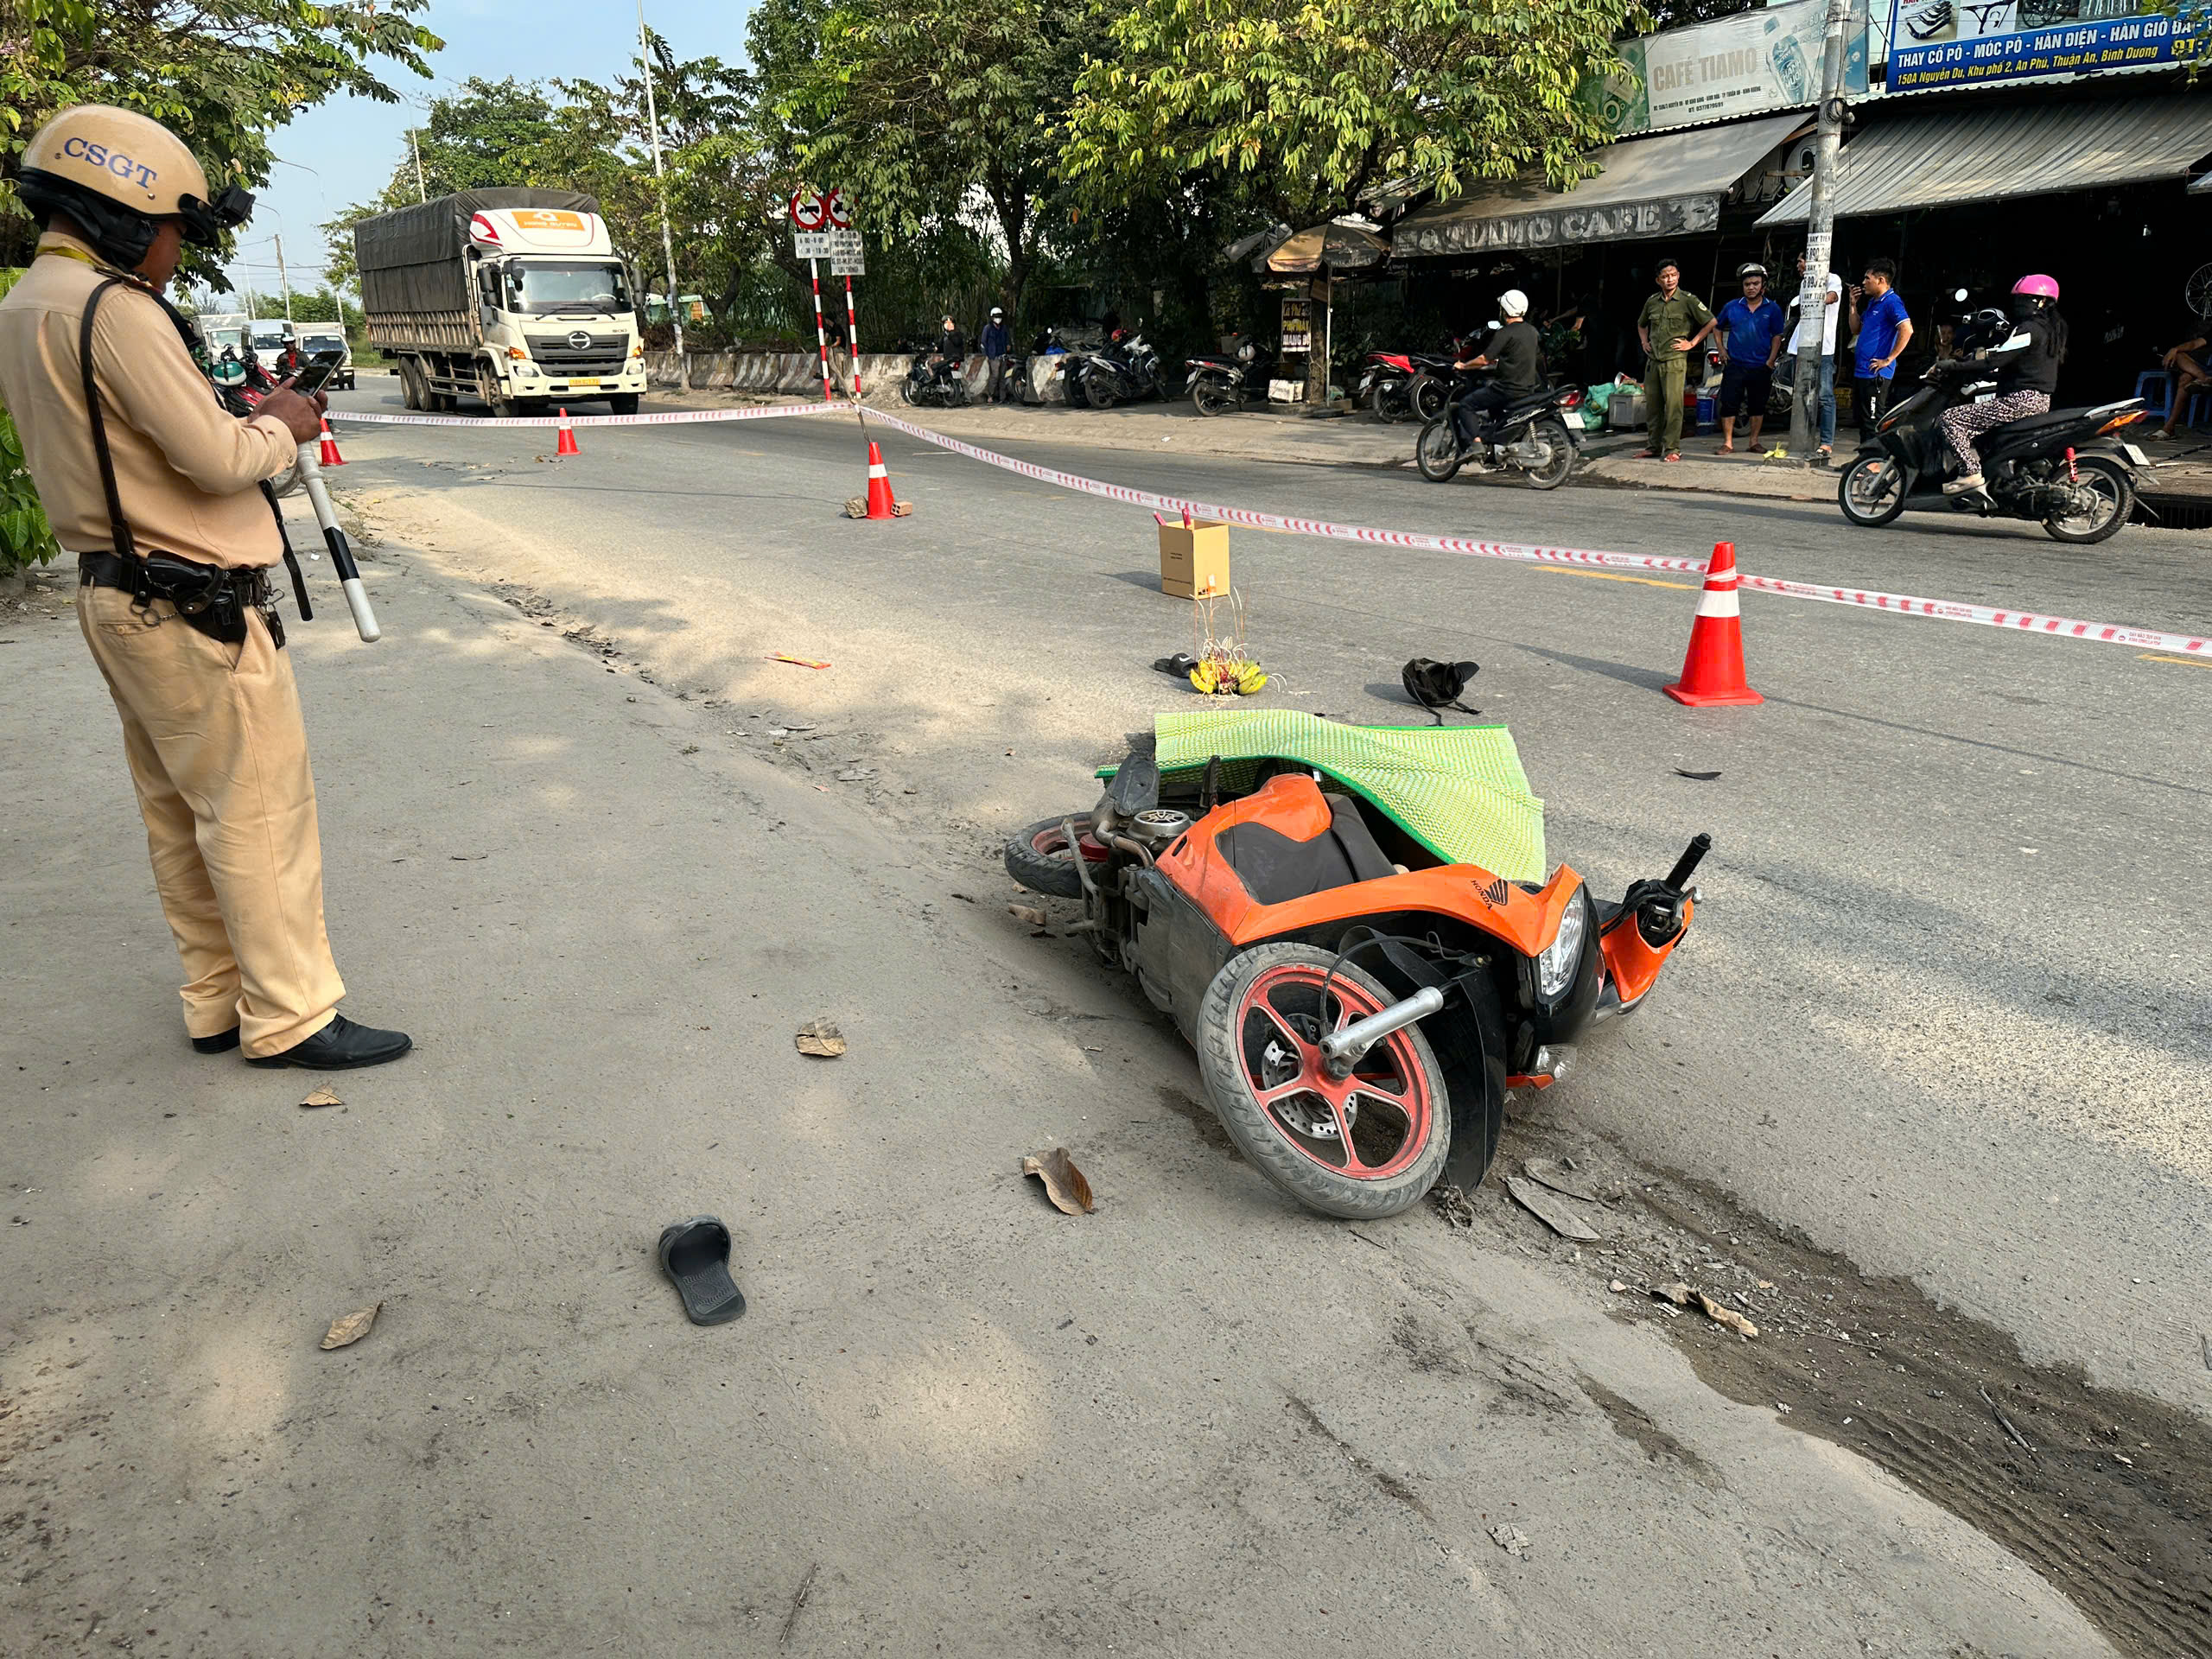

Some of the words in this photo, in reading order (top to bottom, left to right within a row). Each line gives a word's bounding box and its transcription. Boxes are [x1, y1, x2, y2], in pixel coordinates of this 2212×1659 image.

[1897, 52, 1924, 68] THAY
[1928, 43, 1945, 65] CỔ
[1946, 44, 1962, 62] PÔ
[1974, 40, 2002, 59] MÓC
[2005, 36, 2023, 54] PÔ
[2034, 32, 2063, 51] HÀN
[2065, 28, 2098, 48] ĐIỆN
[2110, 22, 2140, 41] HÀN
[2143, 17, 2168, 38] GIÓ
[1653, 56, 1694, 92] CAFÉ
[1698, 48, 1758, 83] TIAMO
[1897, 73, 1916, 86] 150A
[1967, 65, 1985, 78] Khu
[1986, 60, 2005, 77] phố
[2004, 60, 2012, 73] 2,
[2015, 60, 2028, 72] An
[2052, 53, 2082, 68] Thuận
[2082, 52, 2098, 64] An,
[64, 137, 158, 189] CSGT
[1471, 880, 1493, 912] HONDA
